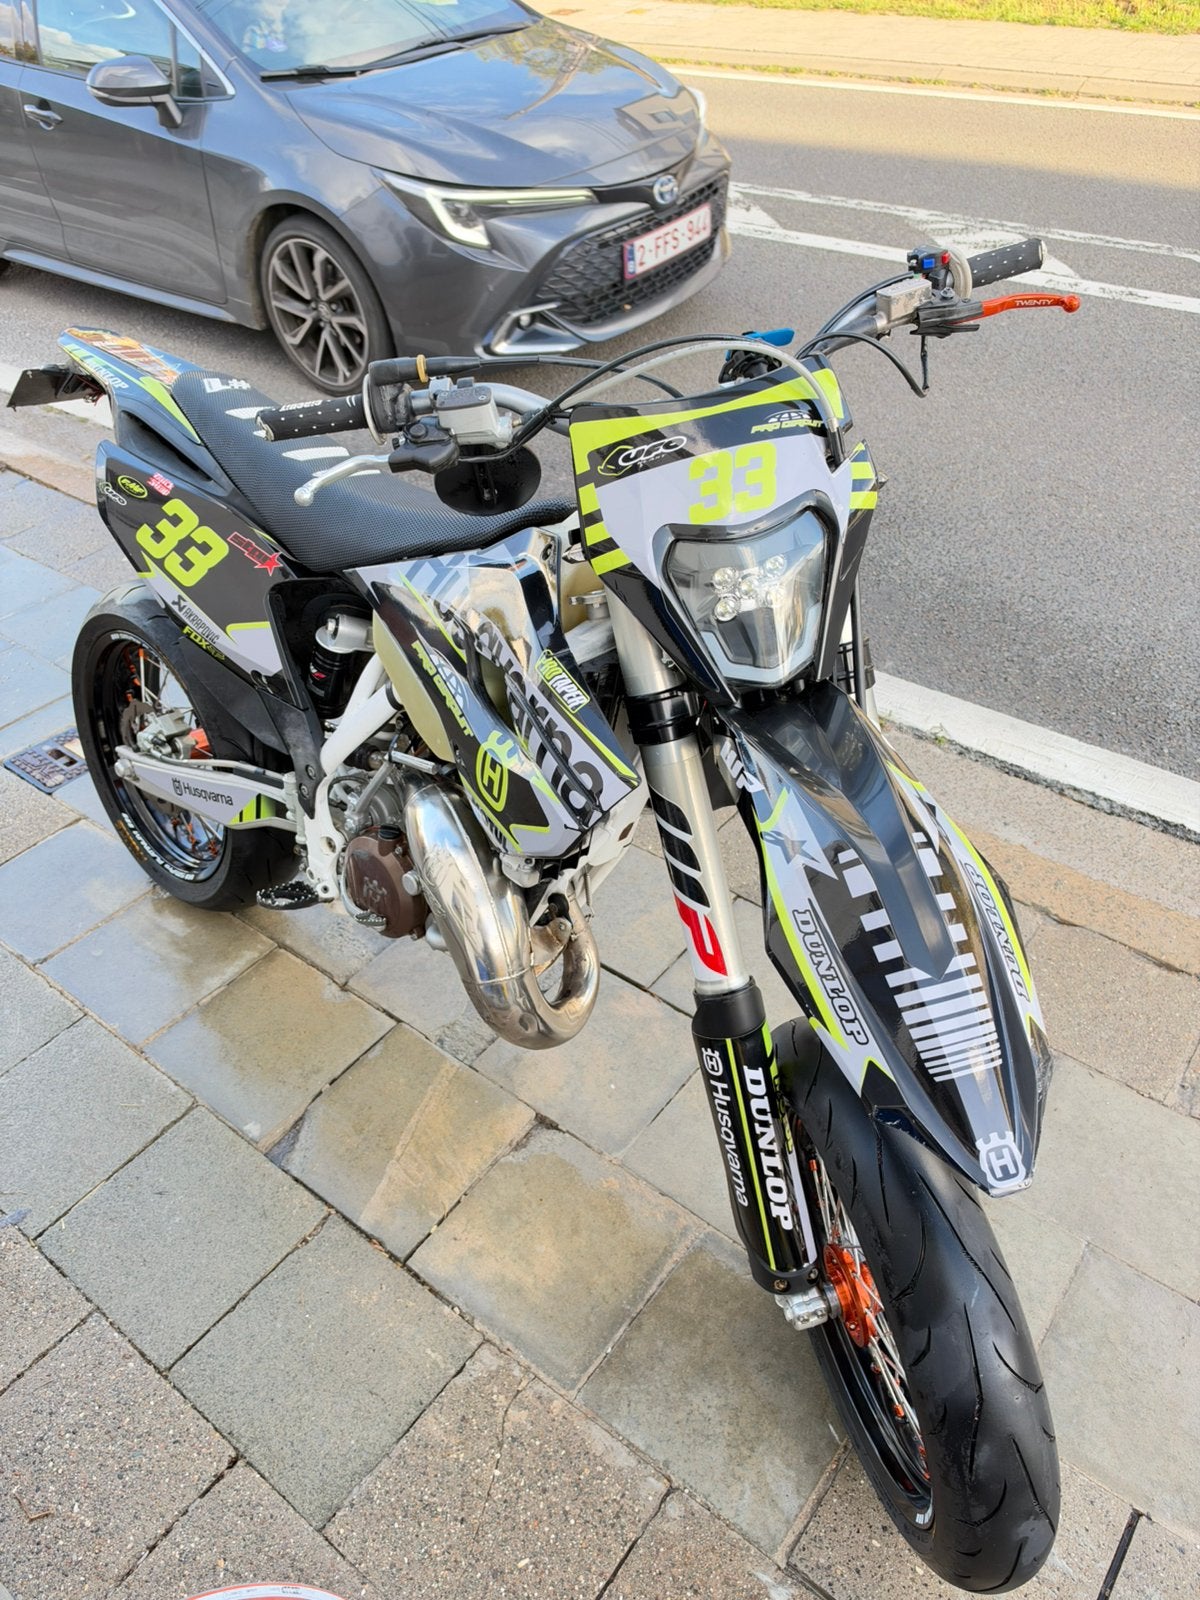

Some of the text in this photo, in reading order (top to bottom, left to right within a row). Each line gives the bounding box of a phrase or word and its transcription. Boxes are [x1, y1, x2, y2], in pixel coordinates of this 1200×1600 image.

[1014, 298, 1053, 307] TWENTY
[689, 441, 778, 525] 33
[136, 498, 229, 587] 33
[182, 782, 235, 806] Husqvarna
[792, 909, 870, 1046] DUNLOP
[964, 862, 1031, 1004] DUNLOP
[710, 1078, 750, 1209] Husqvarna
[743, 1064, 794, 1231] DUNLOP
